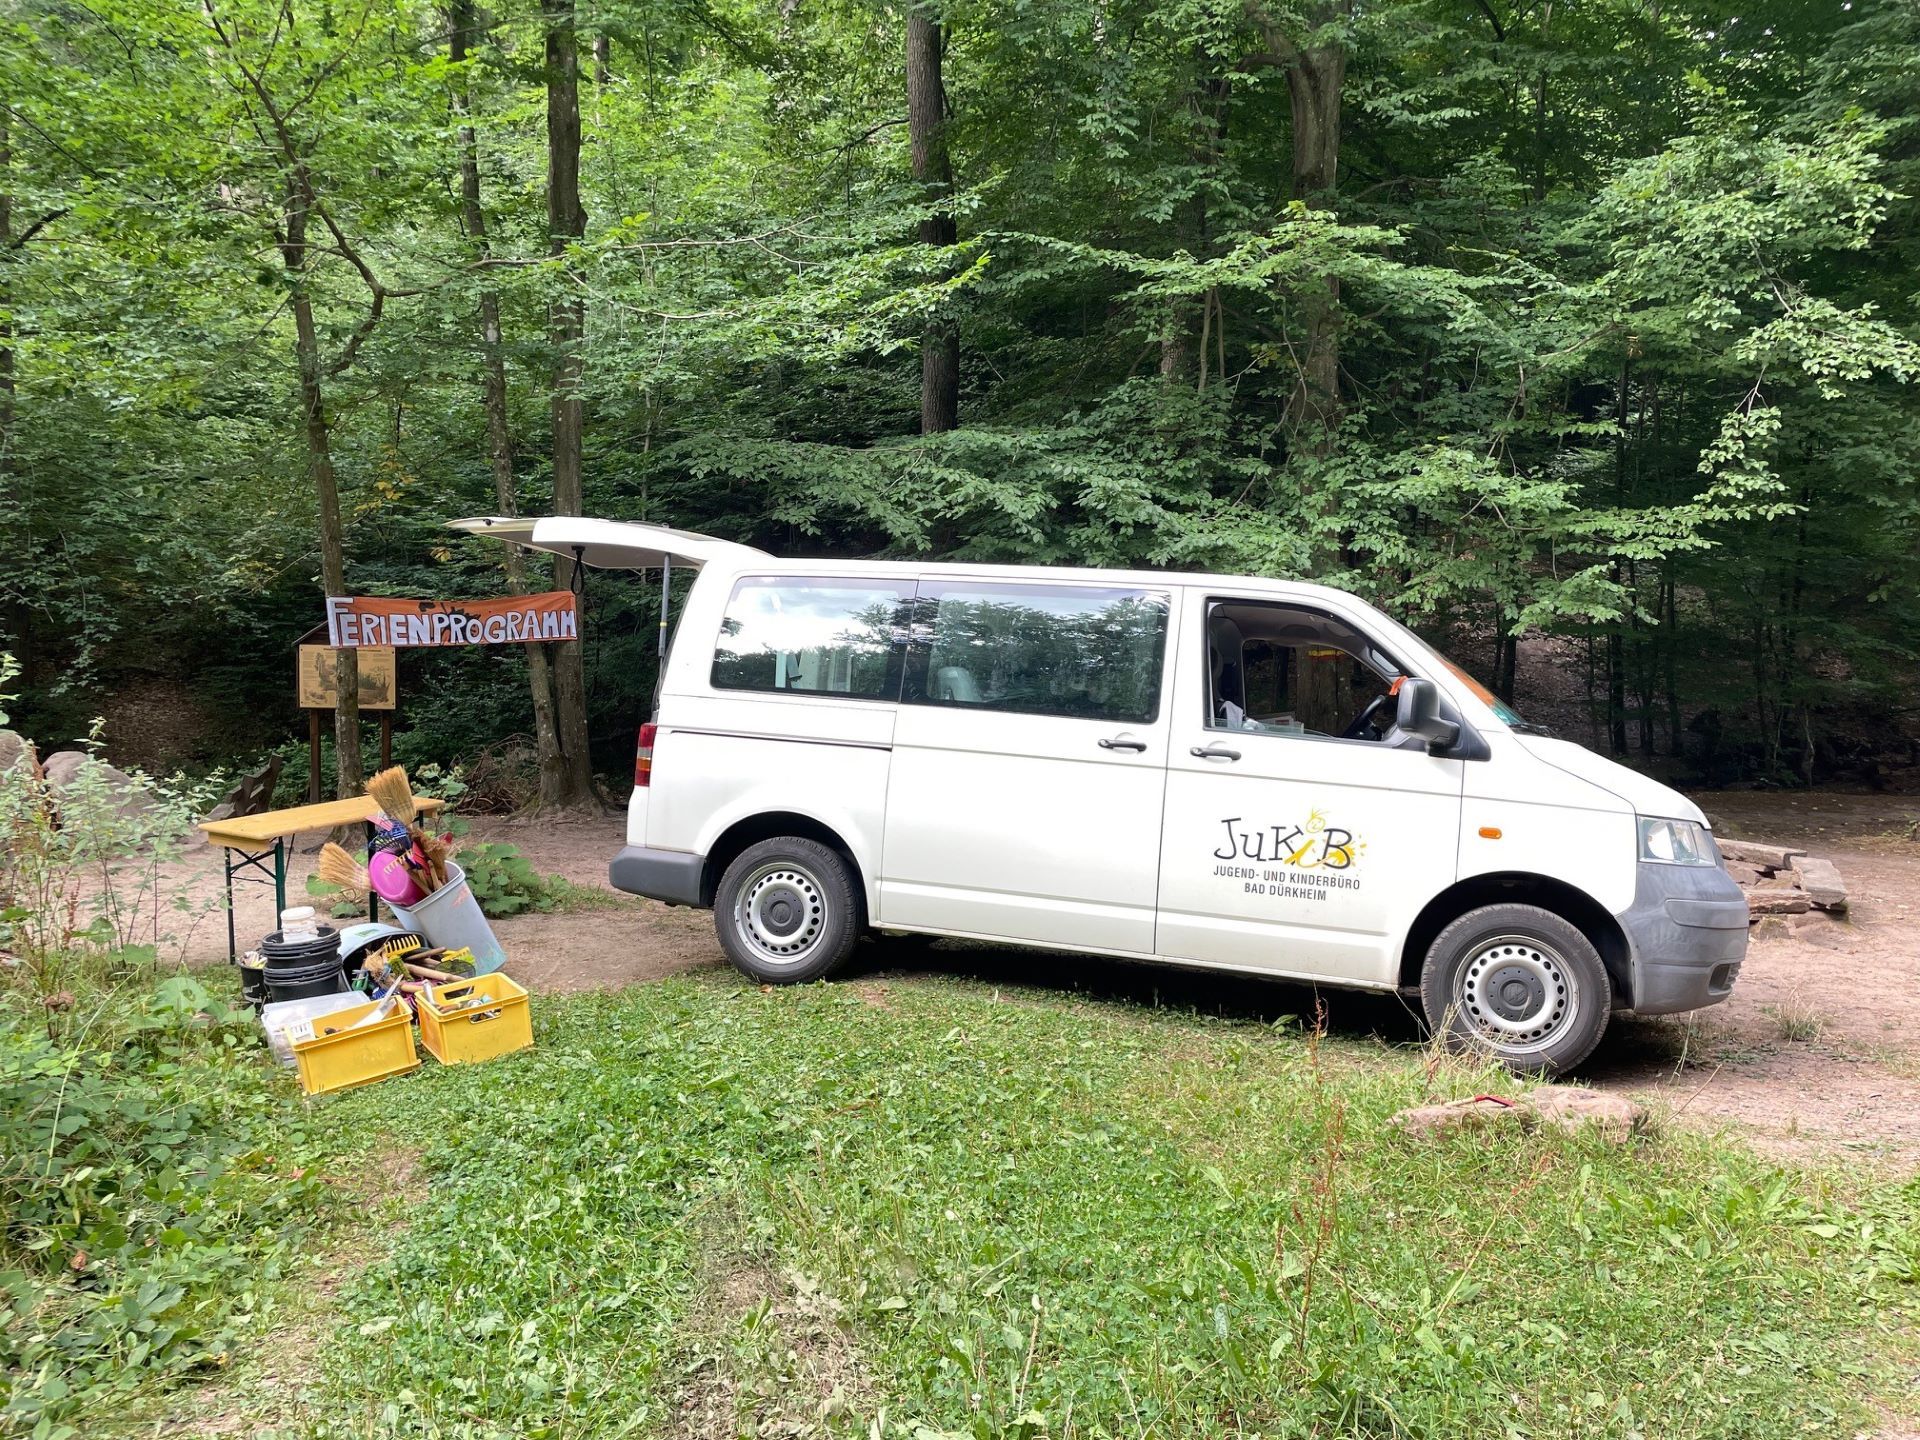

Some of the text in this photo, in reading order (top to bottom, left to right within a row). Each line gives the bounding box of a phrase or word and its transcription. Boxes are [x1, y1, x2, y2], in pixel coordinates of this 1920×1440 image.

[326, 597, 577, 647] FERIENPROGRAMM
[1213, 865, 1360, 890] JUGEND- UND KINDERBÜRO
[1244, 882, 1327, 901] BAD DÜRKHEIM
